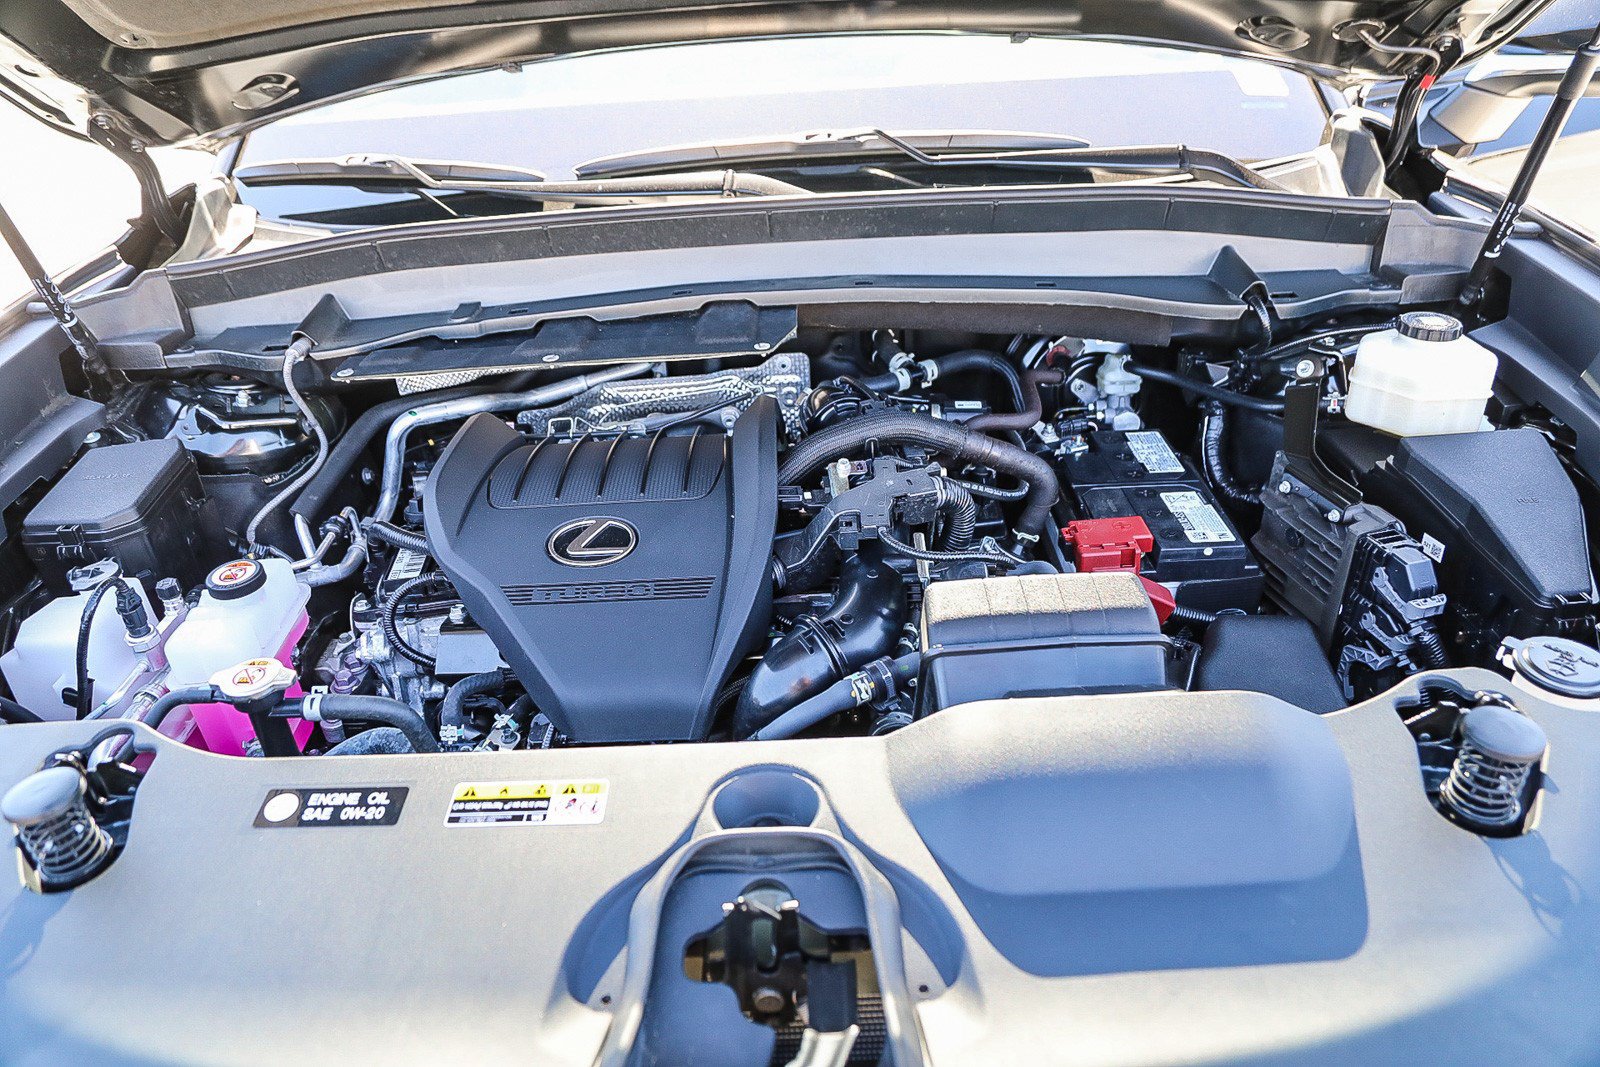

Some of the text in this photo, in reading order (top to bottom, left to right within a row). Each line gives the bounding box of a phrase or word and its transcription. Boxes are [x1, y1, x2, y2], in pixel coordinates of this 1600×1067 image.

[531, 583, 655, 602] TURBO
[307, 791, 390, 806] ENGINE OIL
[301, 806, 386, 821] SAE 0W-20
